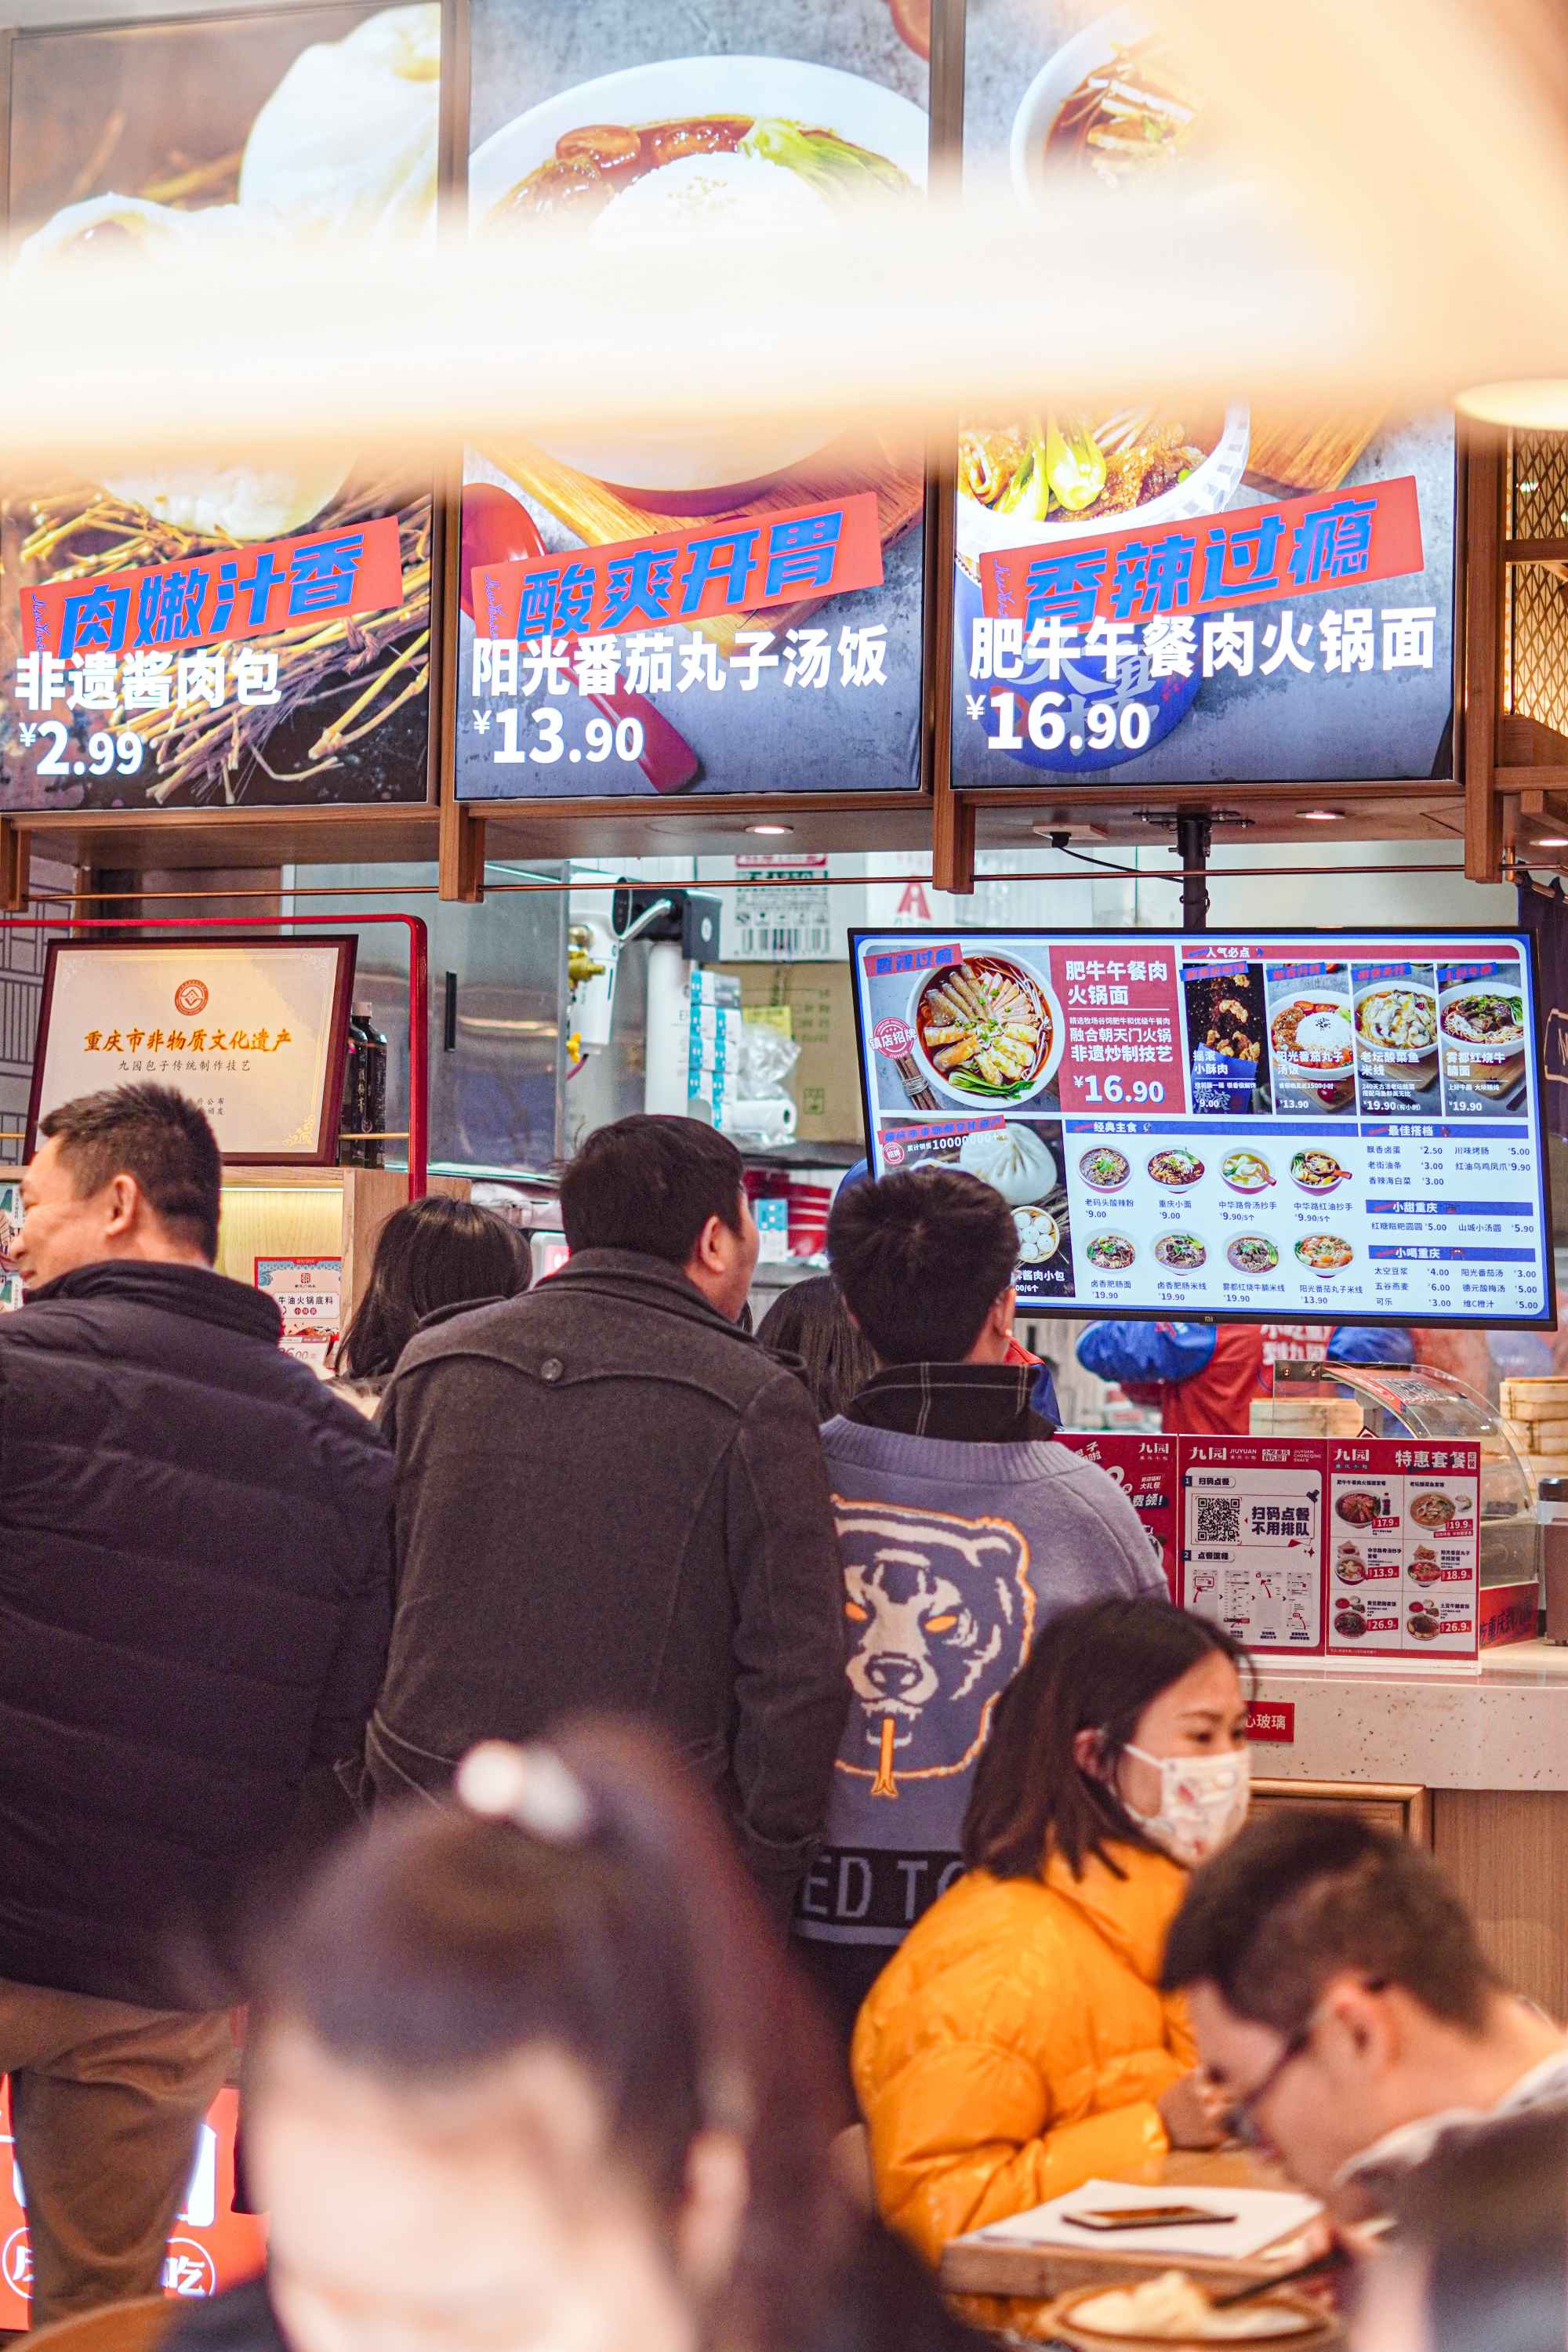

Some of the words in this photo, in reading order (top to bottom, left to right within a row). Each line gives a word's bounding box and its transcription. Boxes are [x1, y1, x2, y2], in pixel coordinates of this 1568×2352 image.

[1023, 498, 1378, 631] 香辣过瘾
[517, 510, 844, 643] 酸爽开胃
[58, 533, 365, 659] 肉嫩汁香
[969, 606, 1437, 680] 肥牛午餐肉火锅面
[471, 623, 887, 696] 阳光番茄丸子汤饭
[15, 649, 282, 712] 非遗酱肉包
[965, 691, 1151, 750] ¥16.90
[473, 707, 644, 764] ¥13.90
[19, 721, 144, 775] ¥2.99
[1206, 946, 1250, 958] 人气必点
[1065, 960, 1167, 981] 肥牛午餐肉
[1068, 985, 1128, 1005] 火锅面
[84, 1028, 292, 1053] 重庆市非物质文化遗产
[1069, 1028, 1172, 1043] 融合朝天门火锅
[1071, 1044, 1174, 1062] 非遗炒制技艺
[1276, 1051, 1343, 1062] 阳光番茄丸子
[1360, 1051, 1420, 1063] 老坛酸菜鱼
[1446, 1052, 1506, 1064] 雾都红烧牛
[118, 1059, 251, 1073] 九园包子传统制作技艺
[1194, 1063, 1229, 1075] 小酥肉
[1361, 1065, 1385, 1076] 米线
[1073, 1075, 1165, 1103] ¥16.90
[1093, 1122, 1137, 1133] 经典主食
[1388, 1125, 1434, 1137] 最佳搭档
[1454, 1147, 1490, 1156] 川味烤肠
[1158, 1200, 1192, 1208] 重庆小面
[1392, 1201, 1437, 1214] 小甜重庆
[1458, 1223, 1502, 1232] 山城小汤圆
[1461, 1269, 1504, 1278] 阳光番茄汤
[1299, 1284, 1363, 1294] 阳光番茄丸子米线
[278, 1296, 333, 1305] 牛油火锅底料
[1376, 1298, 1392, 1307] 可乐
[1138, 1443, 1169, 1454] 九园
[1189, 1446, 1227, 1461] 九园
[1334, 1449, 1370, 1461] 九园
[1396, 1450, 1466, 1469] 特惠套餐
[1199, 1477, 1230, 1486] 扫码点餐
[1251, 1506, 1310, 1521] 扫码点餐
[1251, 1522, 1310, 1537] 不用排队
